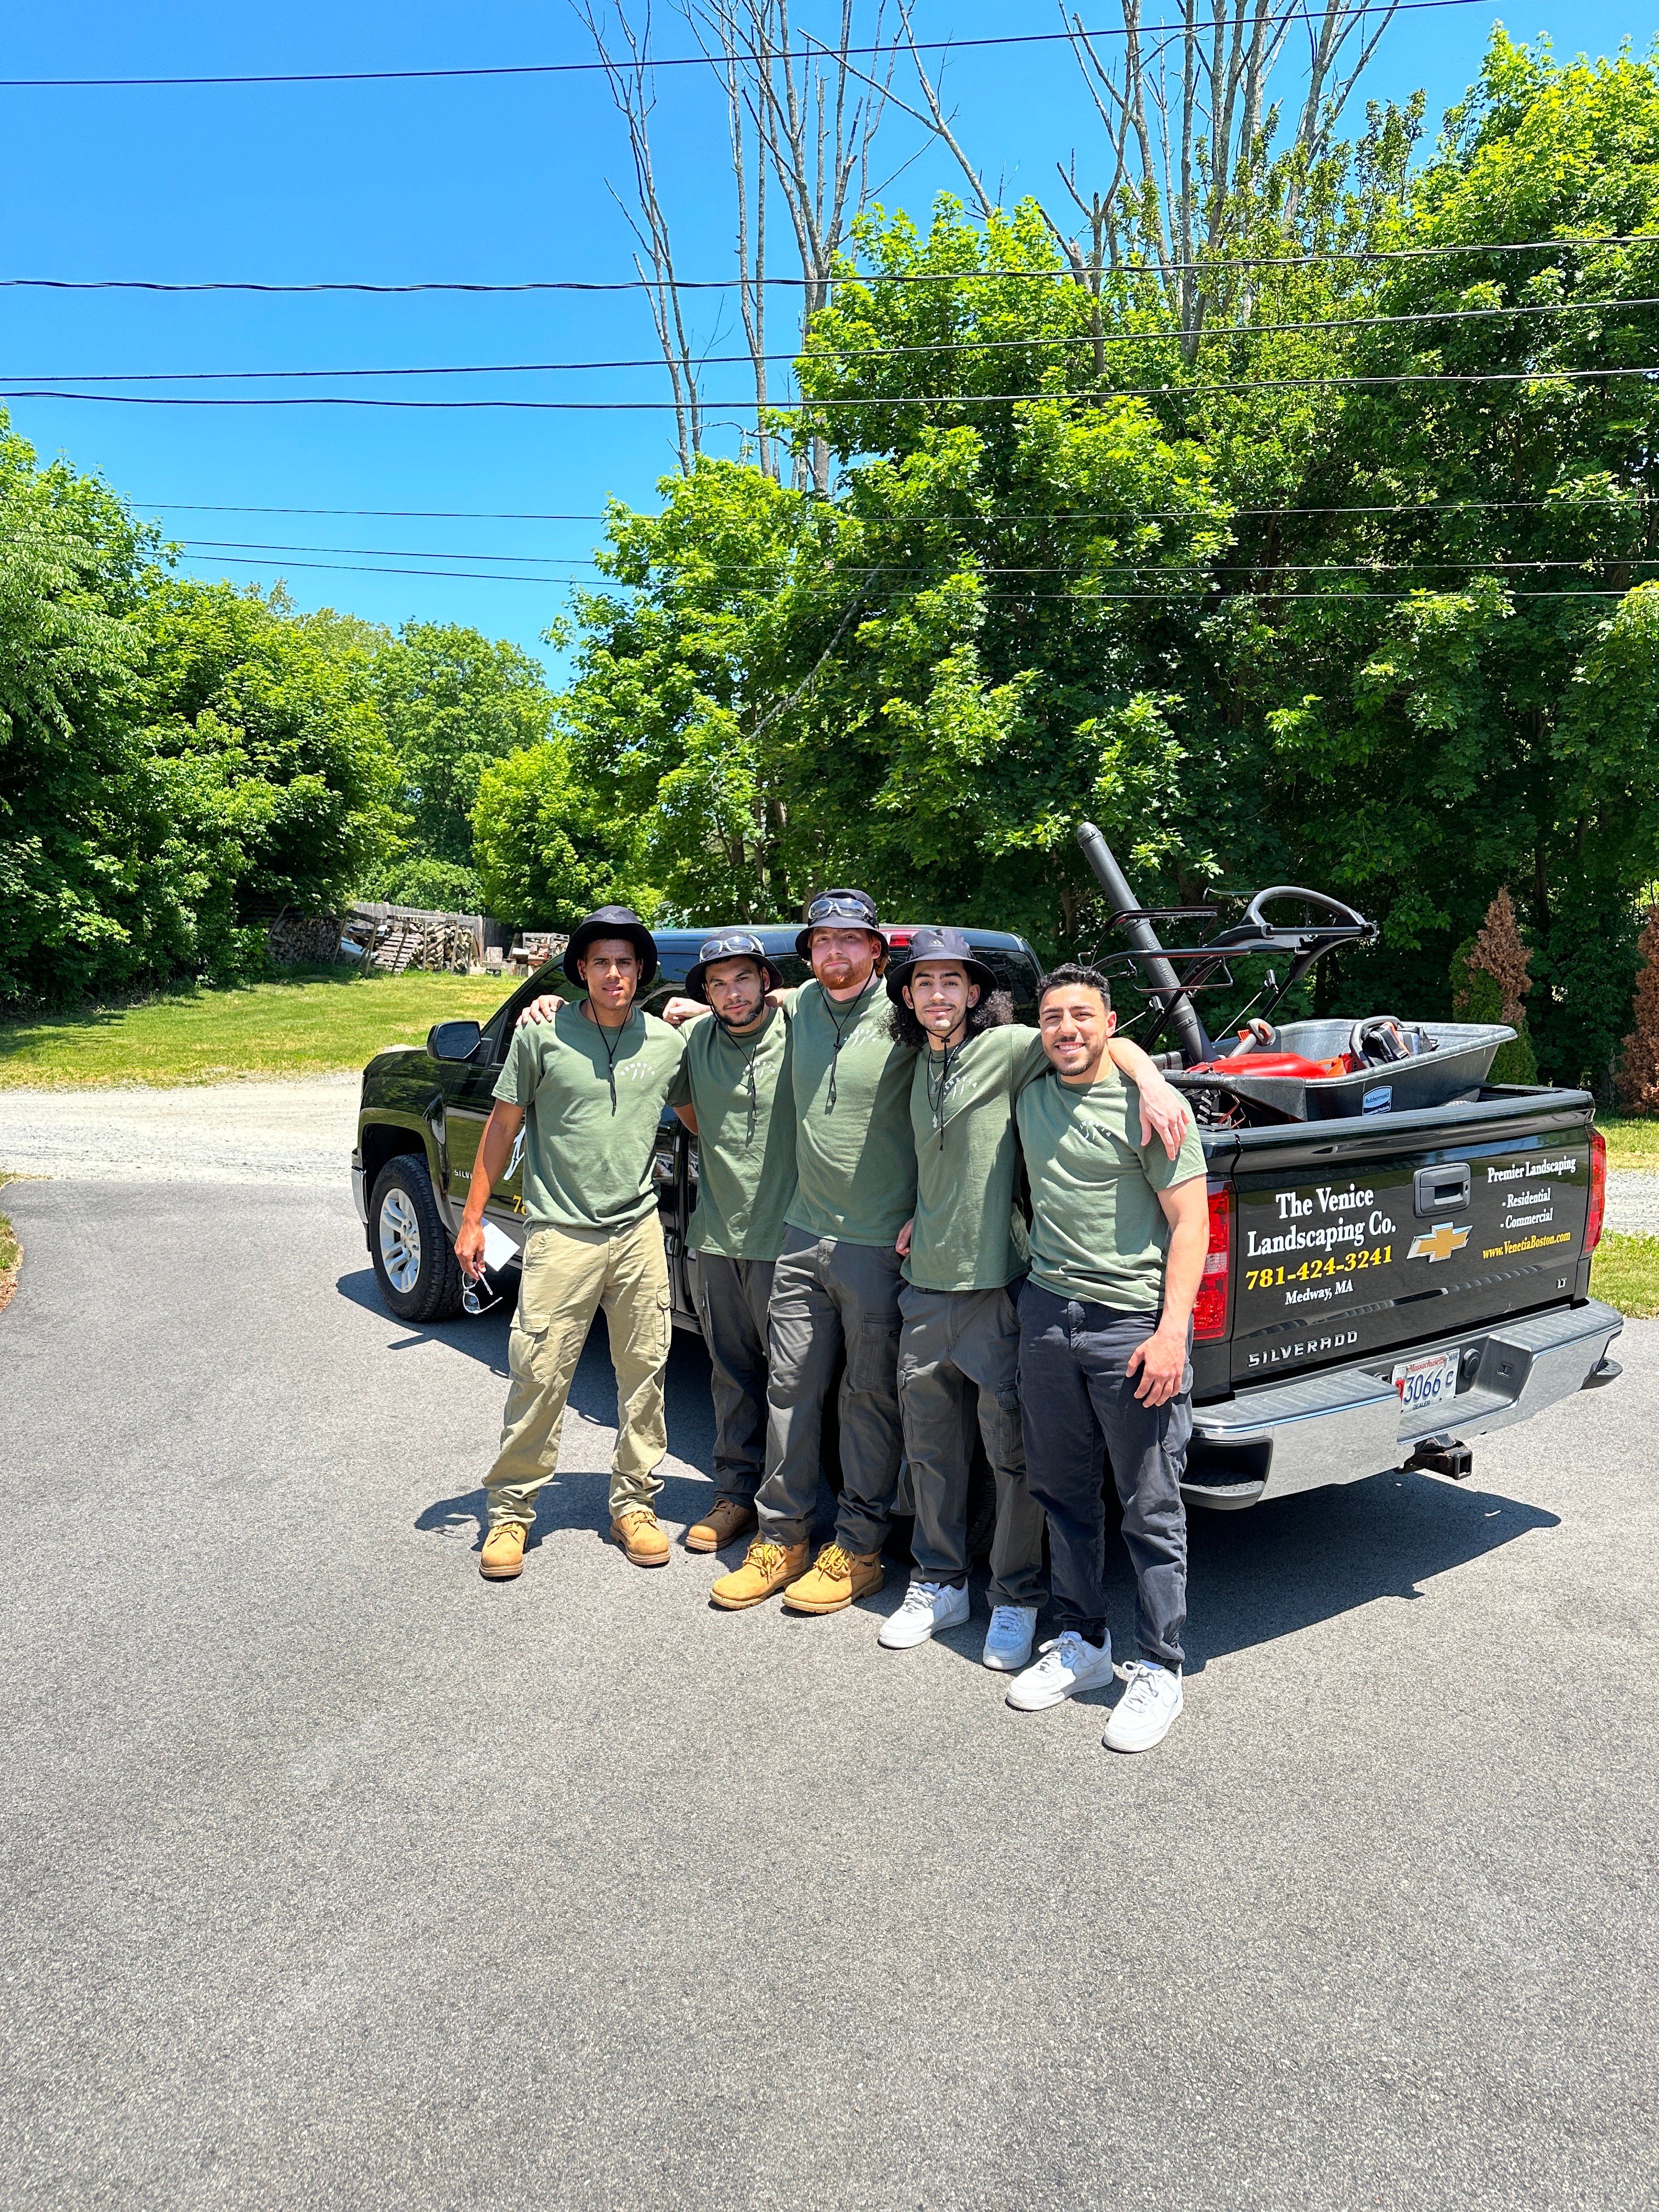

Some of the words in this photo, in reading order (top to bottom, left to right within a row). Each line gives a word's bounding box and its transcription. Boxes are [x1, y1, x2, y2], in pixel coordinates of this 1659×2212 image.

[1487, 1164, 1525, 1183] Premier
[1525, 1155, 1576, 1176] Landscaping
[1276, 1191, 1313, 1219] The
[1316, 1183, 1374, 1213] Venice
[1506, 1187, 1551, 1208] Residential
[1505, 1207, 1554, 1229] Commercial
[1247, 1217, 1365, 1257] Landscaping
[1369, 1210, 1397, 1235] Co.
[1482, 1232, 1571, 1259] www.VenetiaBoston.com
[1245, 1245, 1392, 1290] 781-424-3241
[1285, 1287, 1333, 1305] Medway,
[1334, 1279, 1353, 1295] MA
[1556, 1277, 1567, 1289] LT
[1248, 1330, 1358, 1367] SILVERADO
[1403, 1367, 1444, 1403] 3066
[1446, 1370, 1454, 1386] C
[1413, 1401, 1430, 1410] DEALER
